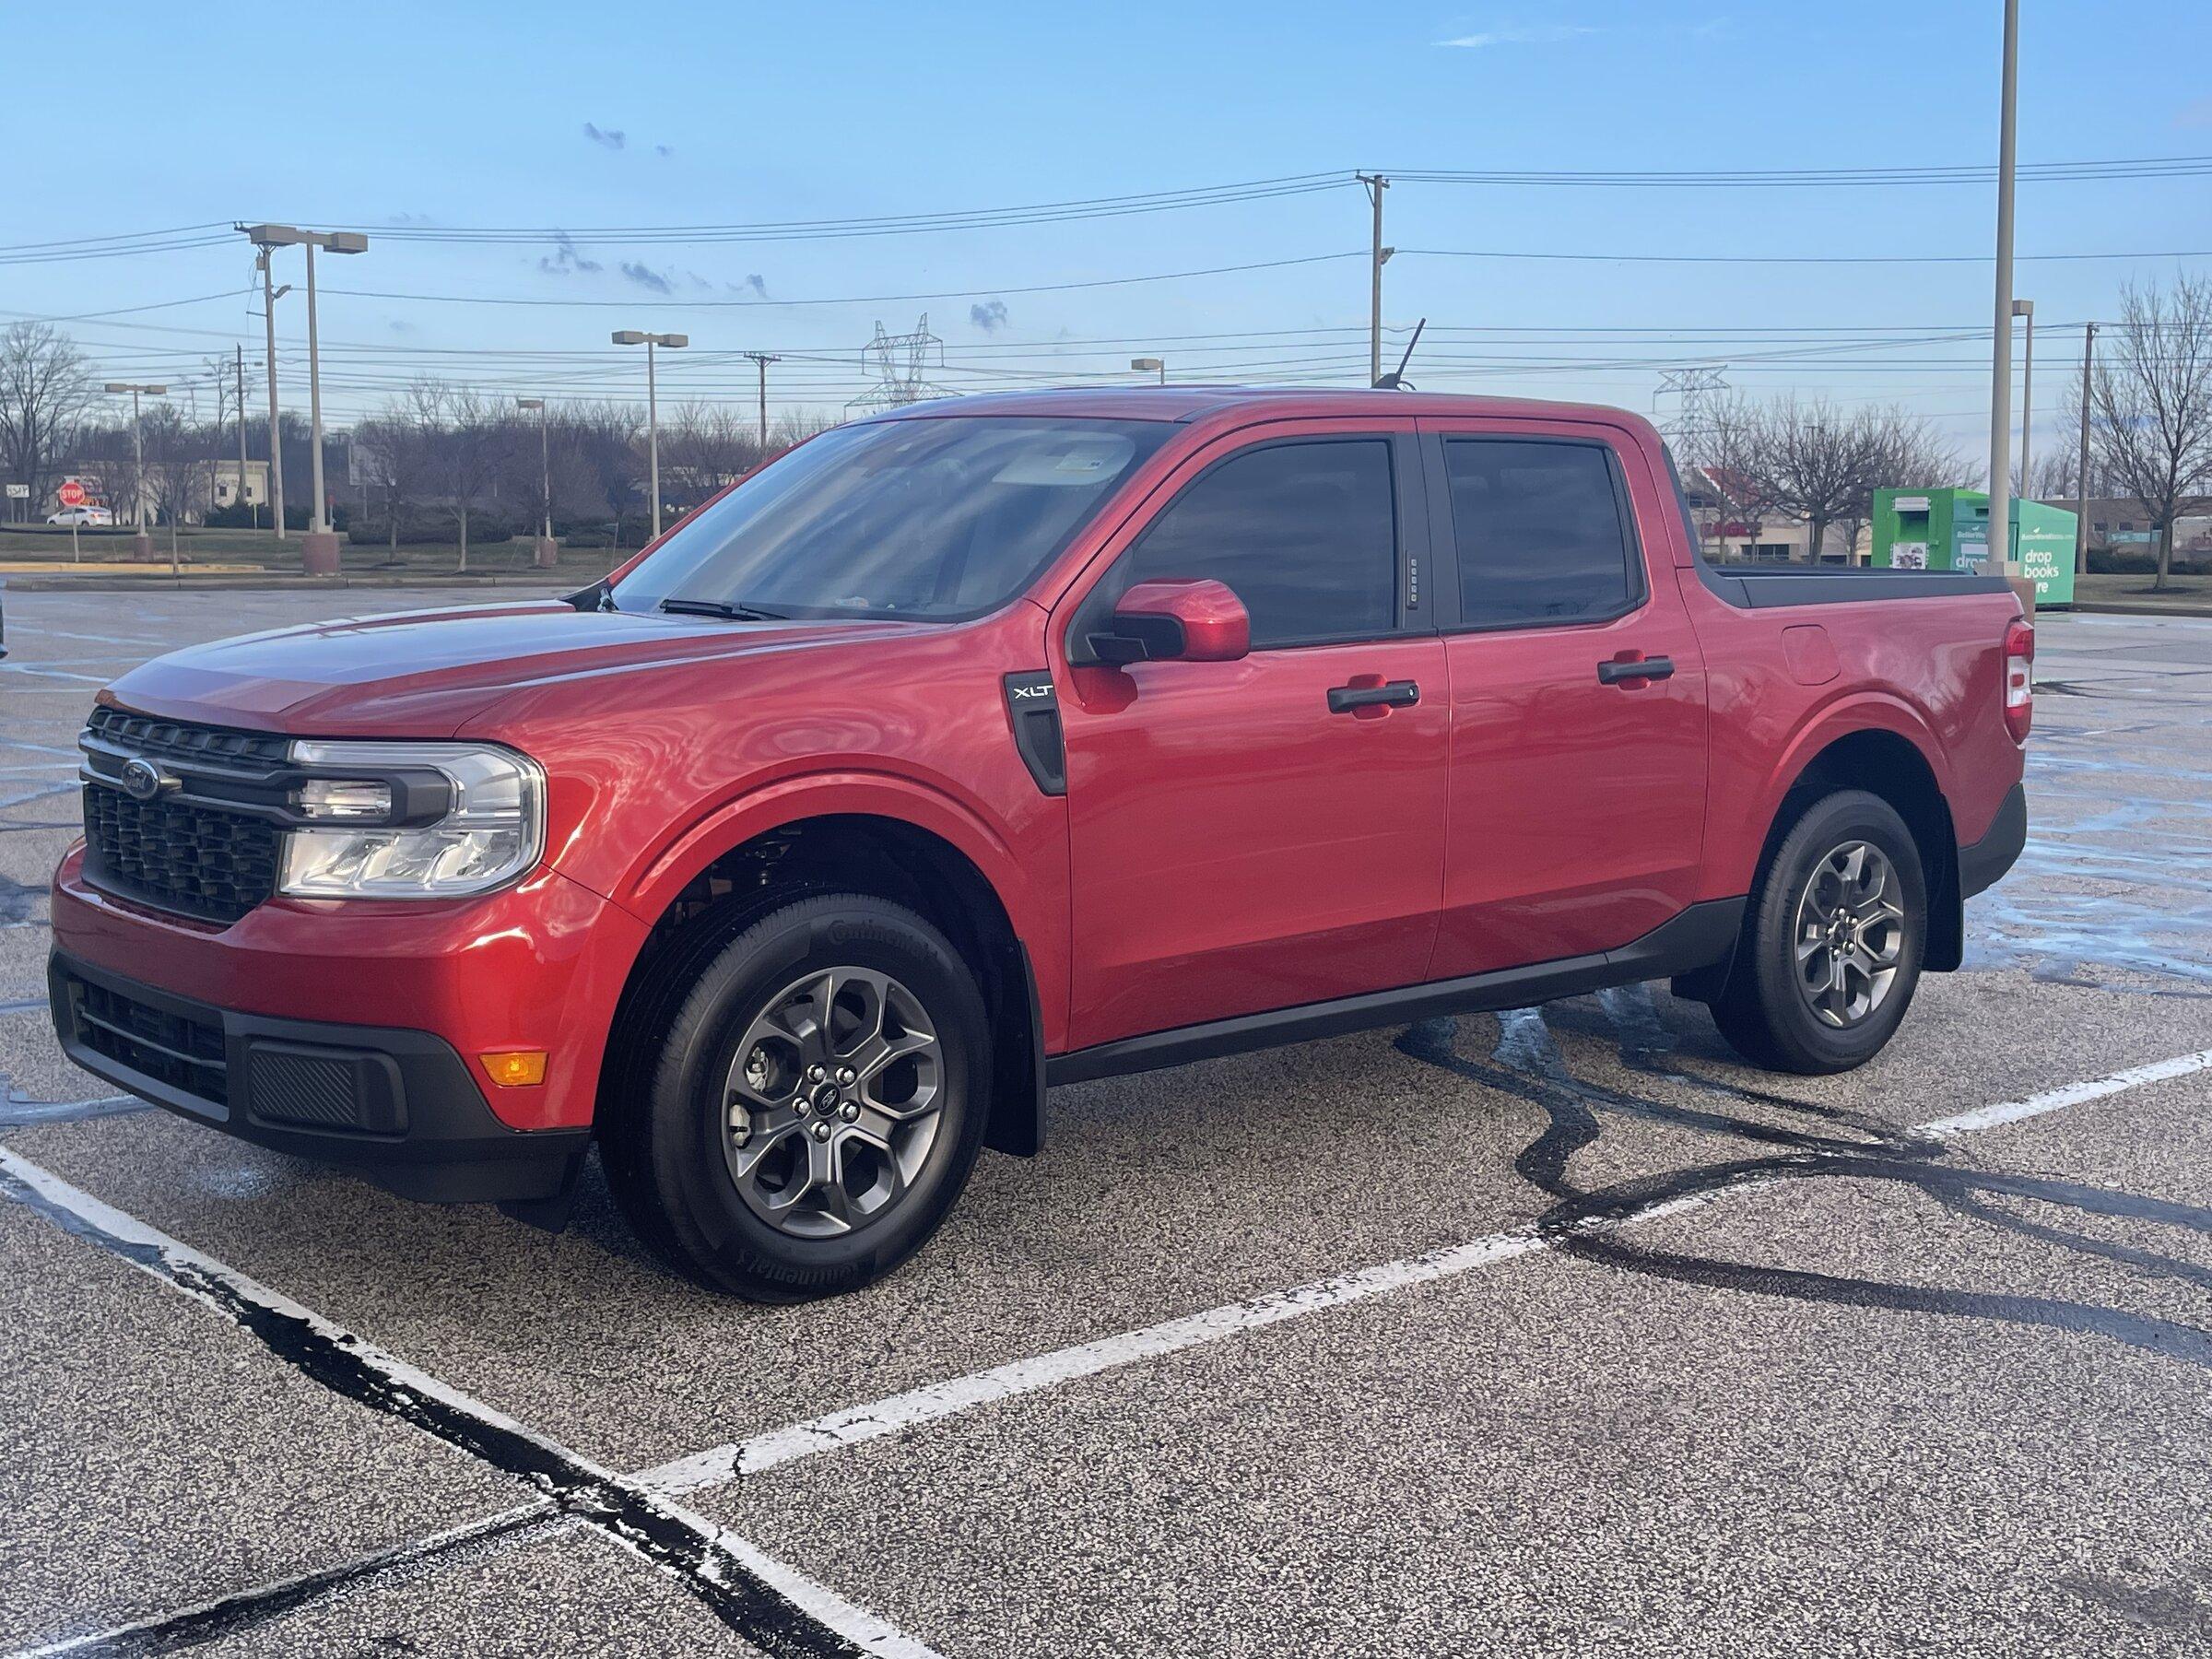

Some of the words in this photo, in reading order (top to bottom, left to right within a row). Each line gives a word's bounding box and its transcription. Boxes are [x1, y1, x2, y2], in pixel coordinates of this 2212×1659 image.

[62, 489, 83, 499] STOP
[2025, 549, 2053, 565] drop
[2024, 564, 2060, 578] books
[2035, 580, 2049, 593] re
[1014, 685, 1053, 700] XLT
